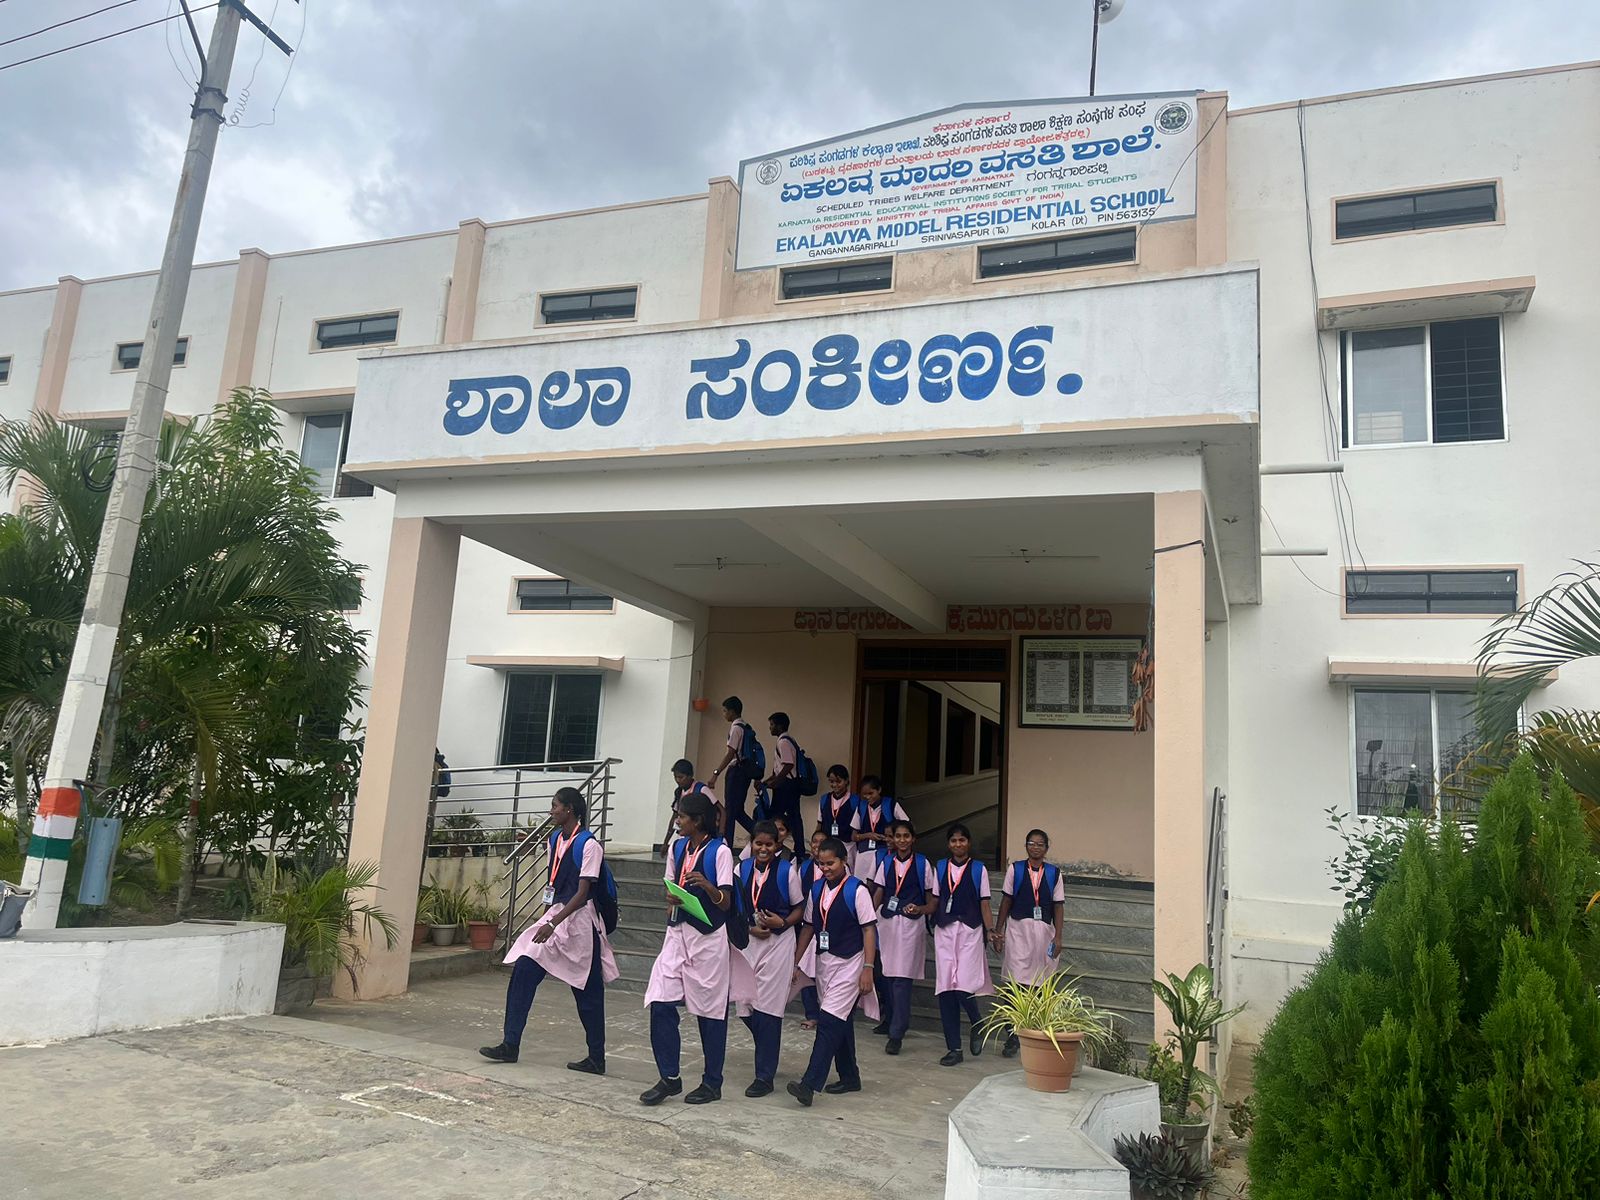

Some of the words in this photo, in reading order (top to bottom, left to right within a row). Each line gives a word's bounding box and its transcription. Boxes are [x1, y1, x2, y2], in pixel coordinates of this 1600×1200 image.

[819, 146, 859, 163] ಪಂಗಡಗಳ
[862, 144, 894, 159] ಕಲ್ಯಾಣ
[951, 125, 994, 143] ಪಂಗಡಗಳ
[995, 123, 1017, 136] ವಸತಿ
[1019, 120, 1046, 133] ಶಾಲಾ
[1049, 114, 1072, 130] ಶಿಕ್ಷಣ
[1119, 101, 1146, 118] ಸಂಘ
[975, 112, 1011, 125] ಸರ್ಕಾರ
[781, 169, 874, 202] ಏಕಲವ್ಯ
[880, 158, 973, 188] ಮಾದರಿ
[980, 140, 1066, 174] ವಸತಿ
[911, 180, 957, 191] GOVERNMENT
[972, 173, 1014, 182] KARNATAKA
[776, 228, 871, 252] EKALAVYA
[877, 219, 942, 240] MODEL
[946, 200, 1085, 230] RESIDENTIAL
[1090, 186, 1174, 212] SCHOOL
[778, 218, 821, 227] KARNATAKA
[824, 211, 872, 222] RESIDENTIAL
[877, 203, 930, 215] EDUCATIONAL
[934, 194, 990, 206] INSTITUTIONS
[993, 189, 1028, 199] SOCIETY
[1051, 182, 1083, 190] TRIBAL
[1088, 174, 1137, 186] STUDENTS
[813, 220, 859, 232] (SPONSORED
[877, 212, 915, 222] MINISTRY
[966, 201, 998, 210] AFFAIRS
[1040, 191, 1064, 200] INDIA)
[817, 201, 863, 213] SCHEDULED
[869, 196, 900, 206] TRIBES
[904, 190, 945, 201] WELFARE
[950, 180, 1013, 195] DEPARTMENT
[809, 240, 898, 257] GANGANNAGARIPALLI
[921, 228, 989, 243] SRINIVASAPUR
[1032, 219, 1065, 230] KOLAR
[1098, 213, 1113, 222] PIN
[1116, 207, 1156, 220] 563135
[442, 364, 631, 437] ಶಾಲಾ
[1086, 607, 1113, 631] ಬಾ
